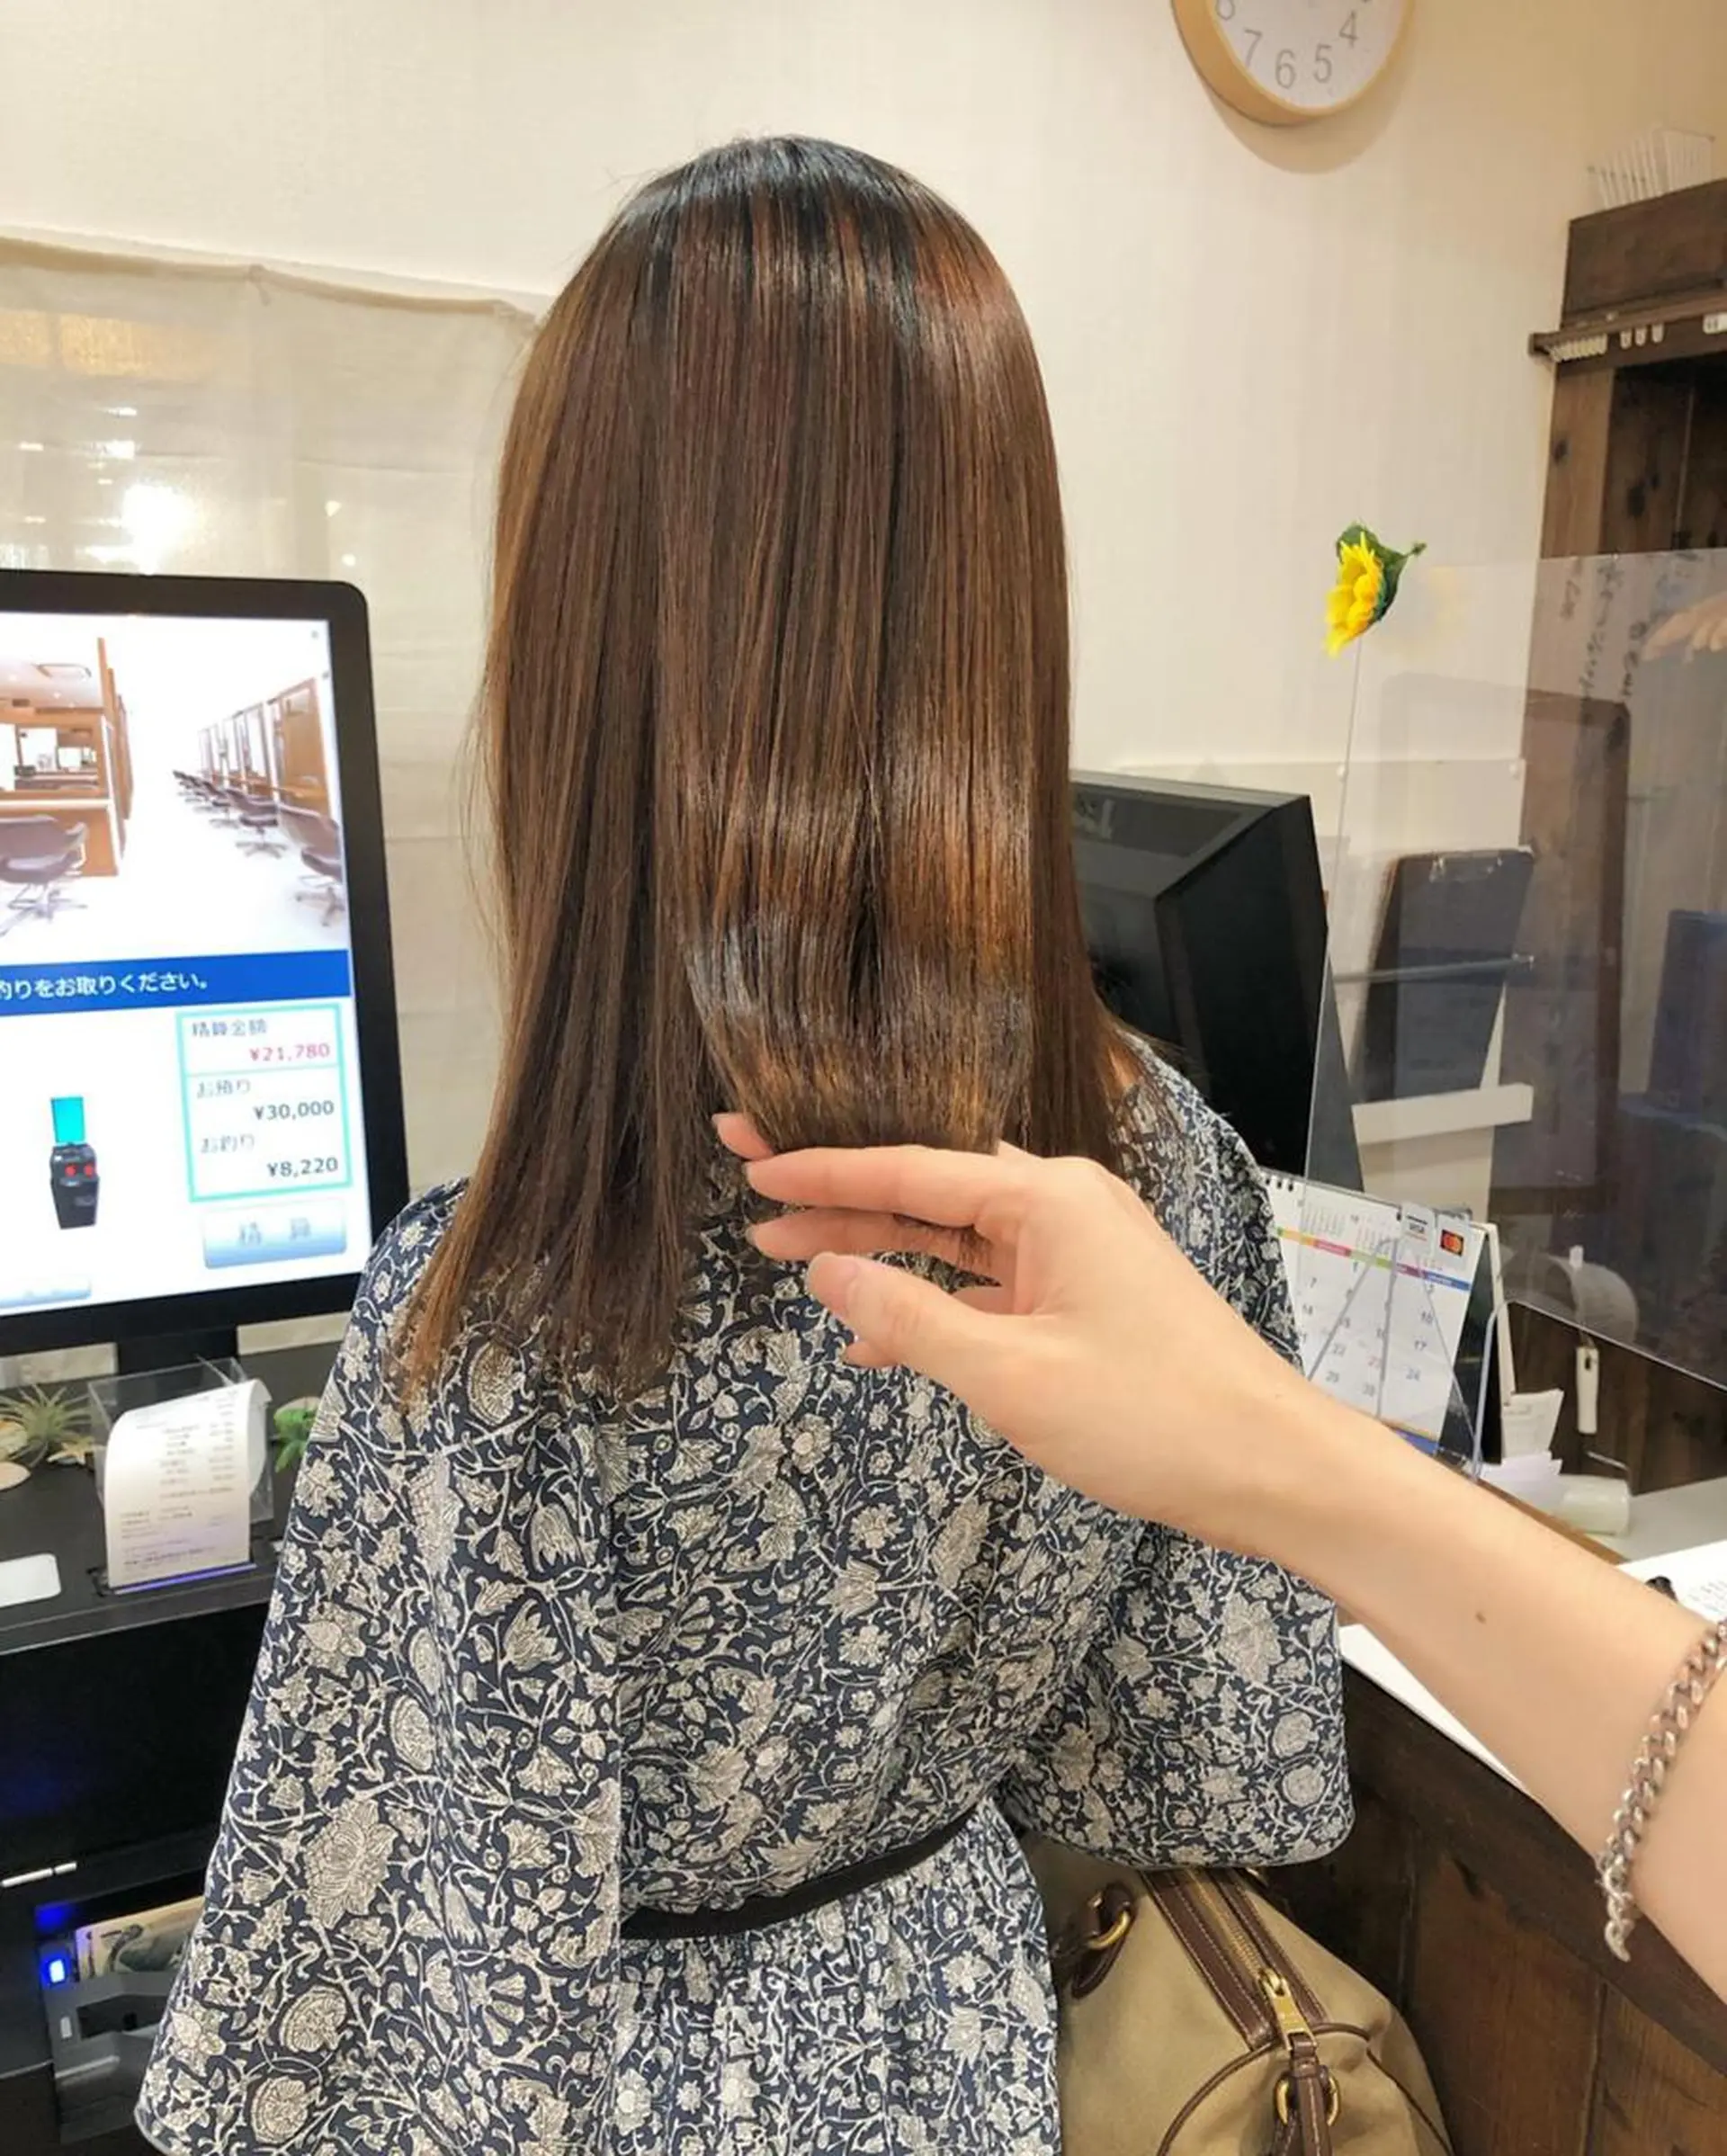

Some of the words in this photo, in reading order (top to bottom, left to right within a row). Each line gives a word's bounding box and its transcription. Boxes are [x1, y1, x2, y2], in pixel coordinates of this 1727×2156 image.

[1244, 27, 1263, 68] 7
[1338, 10, 1358, 48] 4
[1275, 48, 1296, 89] 6
[1312, 43, 1333, 84] 5
[249, 1042, 331, 1062] ¥21,780
[253, 1099, 336, 1122] ¥30,000
[266, 1156, 339, 1178] ¥8,220
